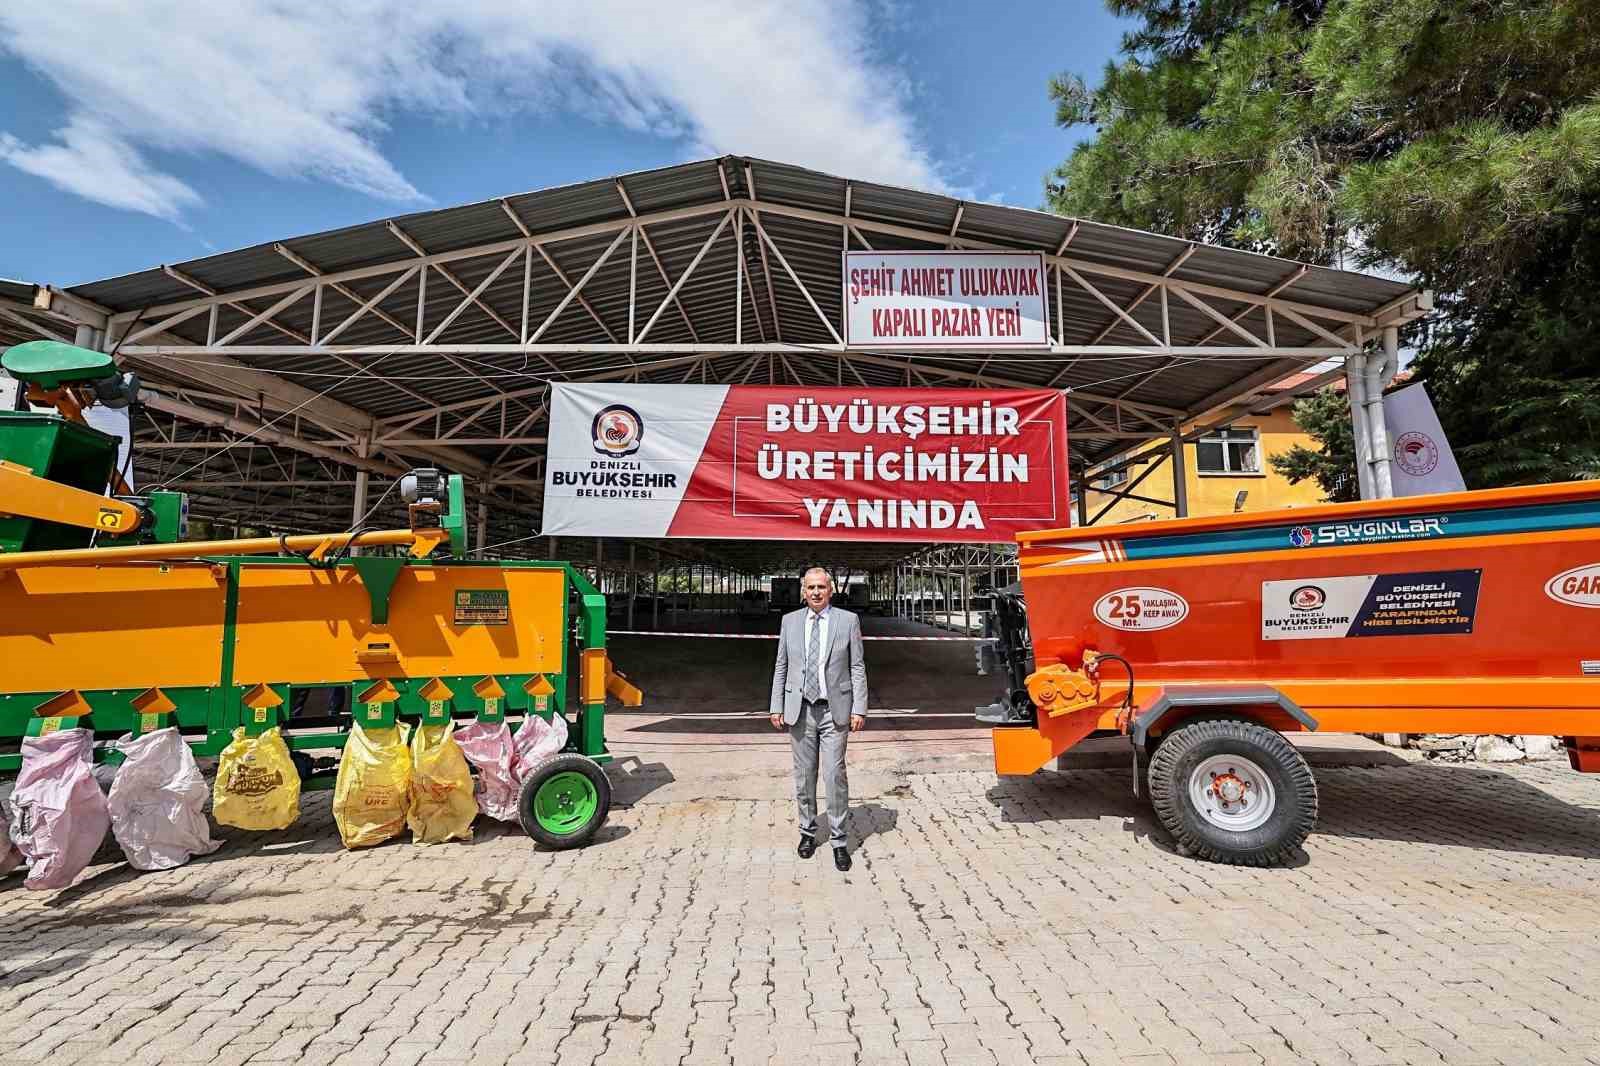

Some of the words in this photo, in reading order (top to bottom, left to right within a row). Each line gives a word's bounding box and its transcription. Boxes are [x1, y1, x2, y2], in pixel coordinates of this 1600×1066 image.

[851, 262, 895, 304] ŞEHİT
[900, 268, 955, 296] AHMET
[959, 268, 1040, 296] ULUKAVAK
[872, 308, 926, 337] KAPALI
[931, 308, 981, 337] PAZAR
[985, 301, 1022, 337] YERİ
[766, 398, 1020, 440] BÜYÜKŞEHİR
[757, 443, 1029, 482] ÜRETİCİMİZİN
[552, 471, 677, 488] BÜYÜKŞEHİR
[802, 498, 985, 529] YANINDA
[1393, 582, 1446, 592] DENİZLİ
[1142, 599, 1178, 608] YAKLAŞMA
[1375, 591, 1462, 602] BÜYÜKŞEHİR
[1108, 595, 1141, 618] 25
[1380, 600, 1456, 610] BELEDİYESİ
[1161, 609, 1180, 617] AWAY
[1373, 609, 1458, 618] TARAFINDAN
[1363, 618, 1392, 627] HİBE
[1395, 616, 1469, 625] EDİLMİŞTİR
